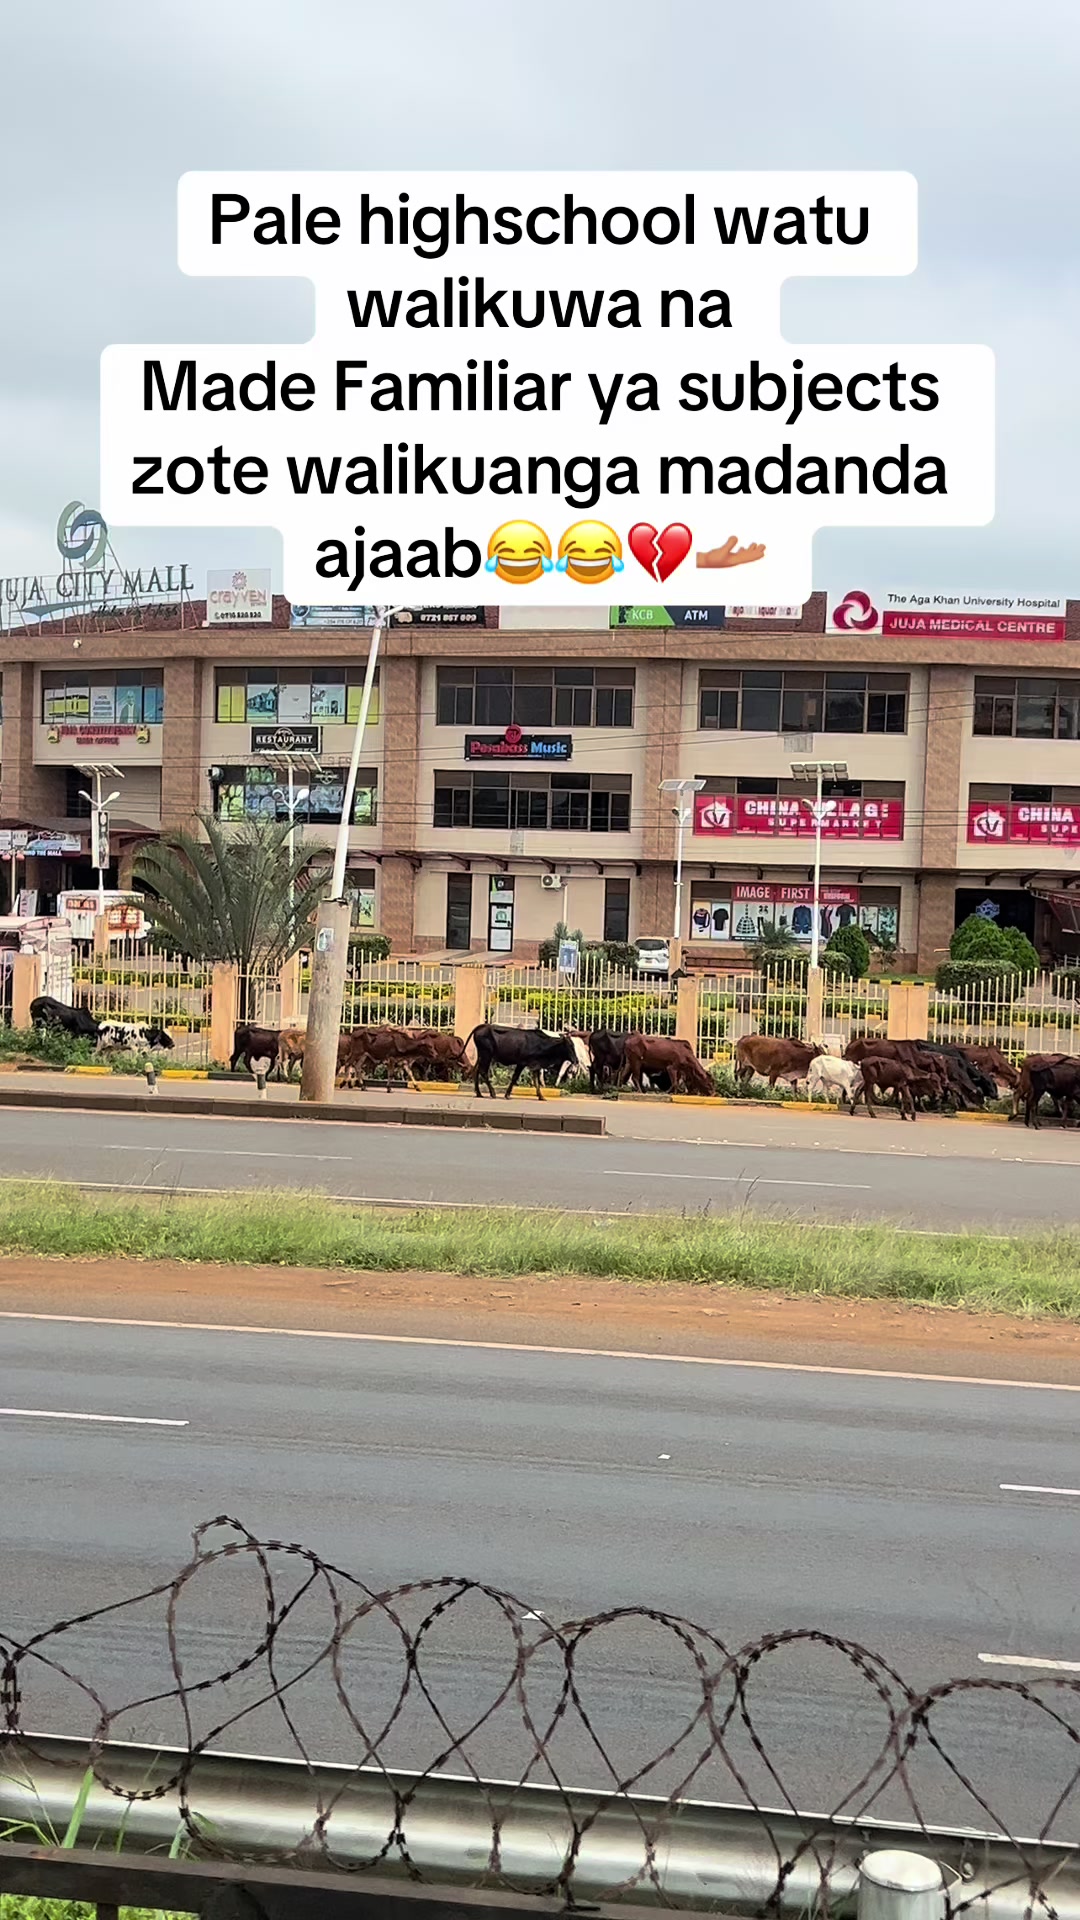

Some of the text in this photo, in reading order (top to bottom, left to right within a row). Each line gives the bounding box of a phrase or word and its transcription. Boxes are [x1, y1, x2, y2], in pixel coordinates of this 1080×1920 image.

[56, 569, 115, 598] CITY
[122, 563, 195, 595] MALL
[887, 593, 1061, 609] The Aga Khan University Hospital
[632, 609, 708, 621] KCB ATM
[889, 617, 1057, 634] JUJA MEDICAL CENTRE
[255, 735, 313, 744] RESTAURANT
[530, 741, 568, 754] Music
[744, 800, 800, 817] CHINA
[1017, 807, 1075, 823] CHINA
[736, 886, 771, 899] IMAGE
[780, 887, 811, 900] FIRST
